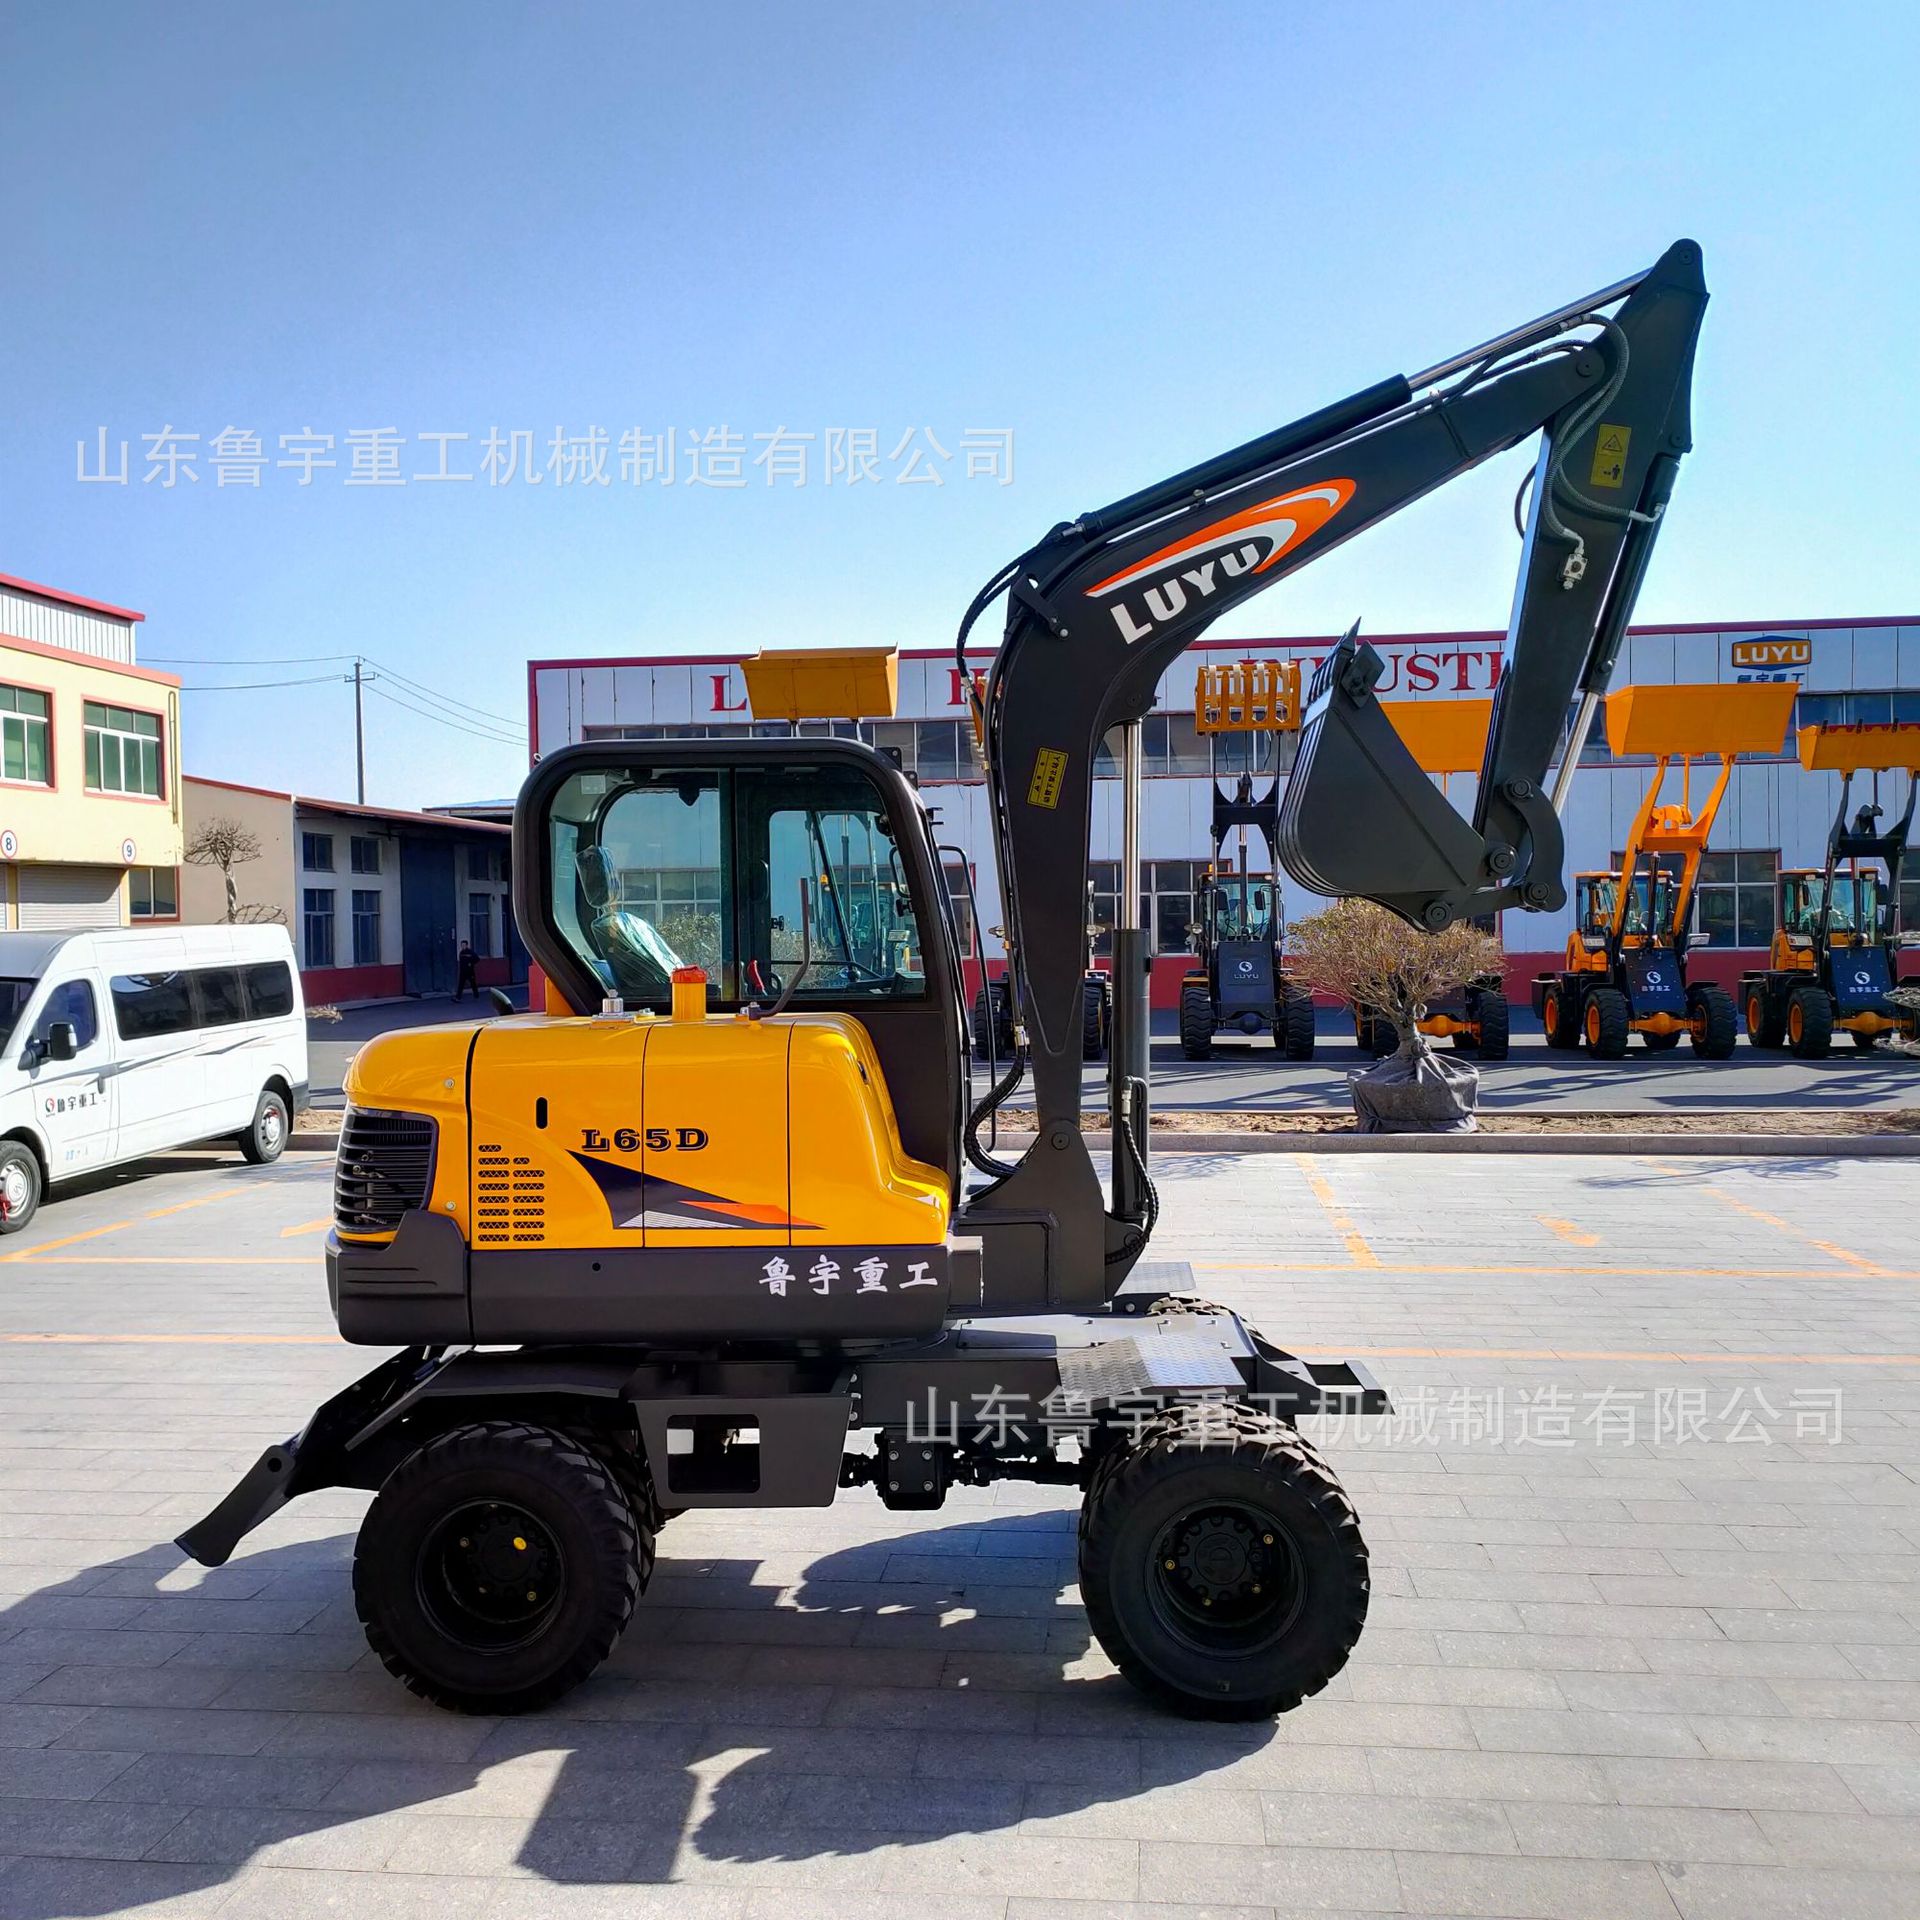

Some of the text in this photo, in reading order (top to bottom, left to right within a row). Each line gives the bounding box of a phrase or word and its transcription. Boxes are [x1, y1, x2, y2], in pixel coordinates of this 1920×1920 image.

[1110, 543, 1260, 645] LUYU
[1736, 645, 1808, 663] LUYU
[5, 837, 13, 851] 8
[126, 844, 133, 857] 9
[581, 1128, 709, 1152] L65D
[759, 1254, 938, 1297] 鲁宇重工
